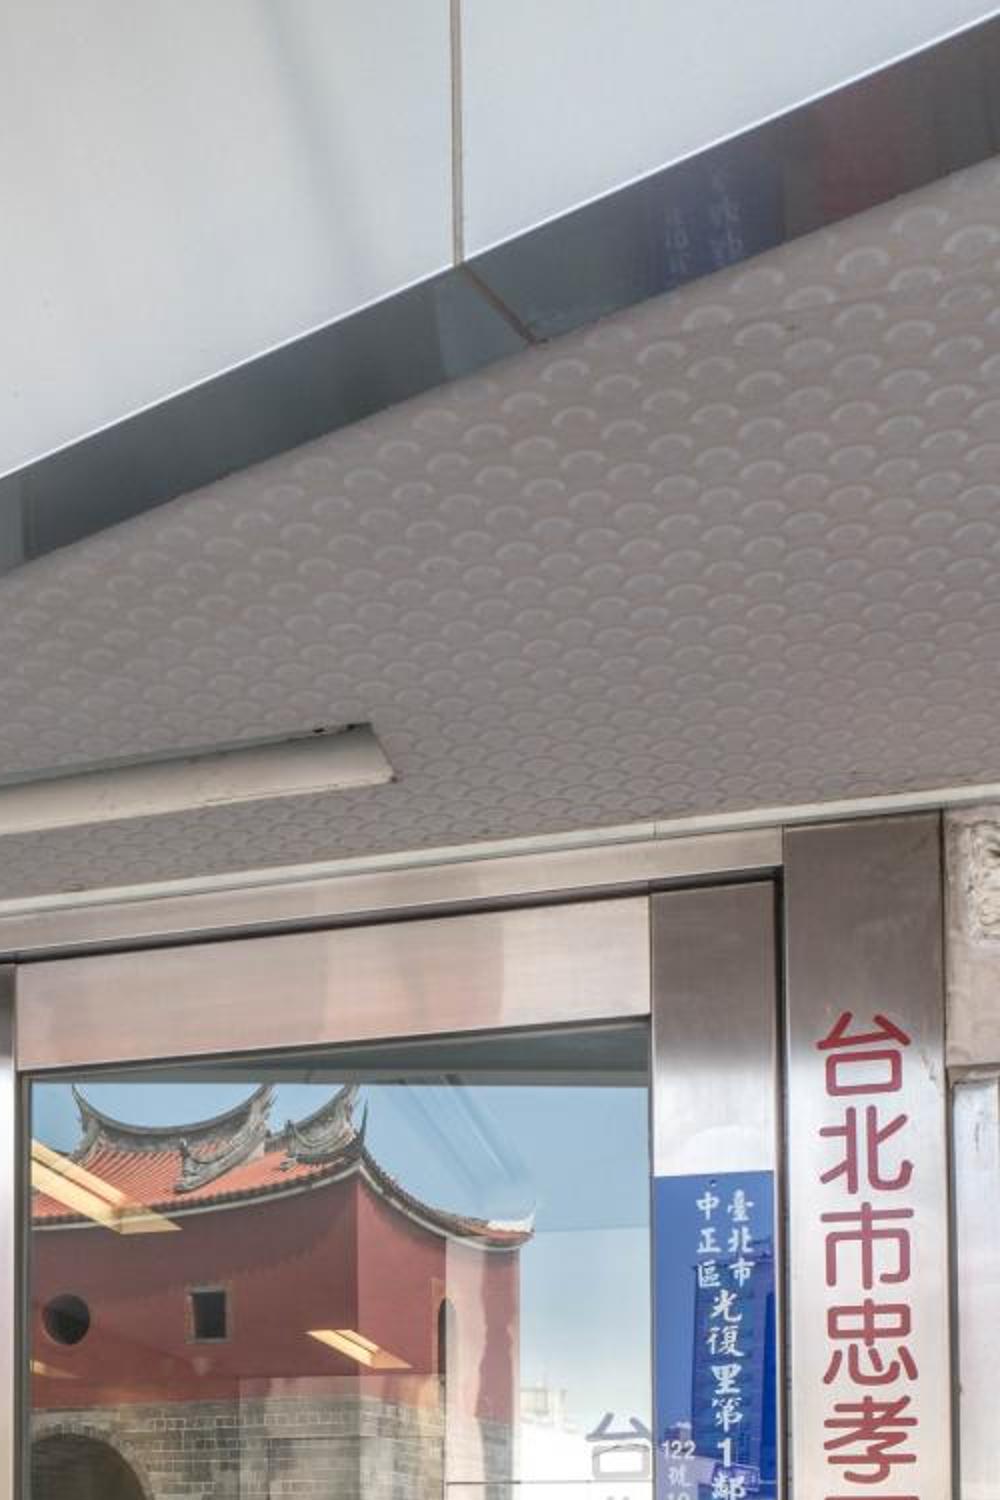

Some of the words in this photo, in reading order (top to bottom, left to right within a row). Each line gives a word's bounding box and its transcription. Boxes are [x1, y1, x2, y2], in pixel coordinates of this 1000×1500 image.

[696, 1191, 721, 1289] 中正區
[727, 1189, 755, 1287] 臺北市
